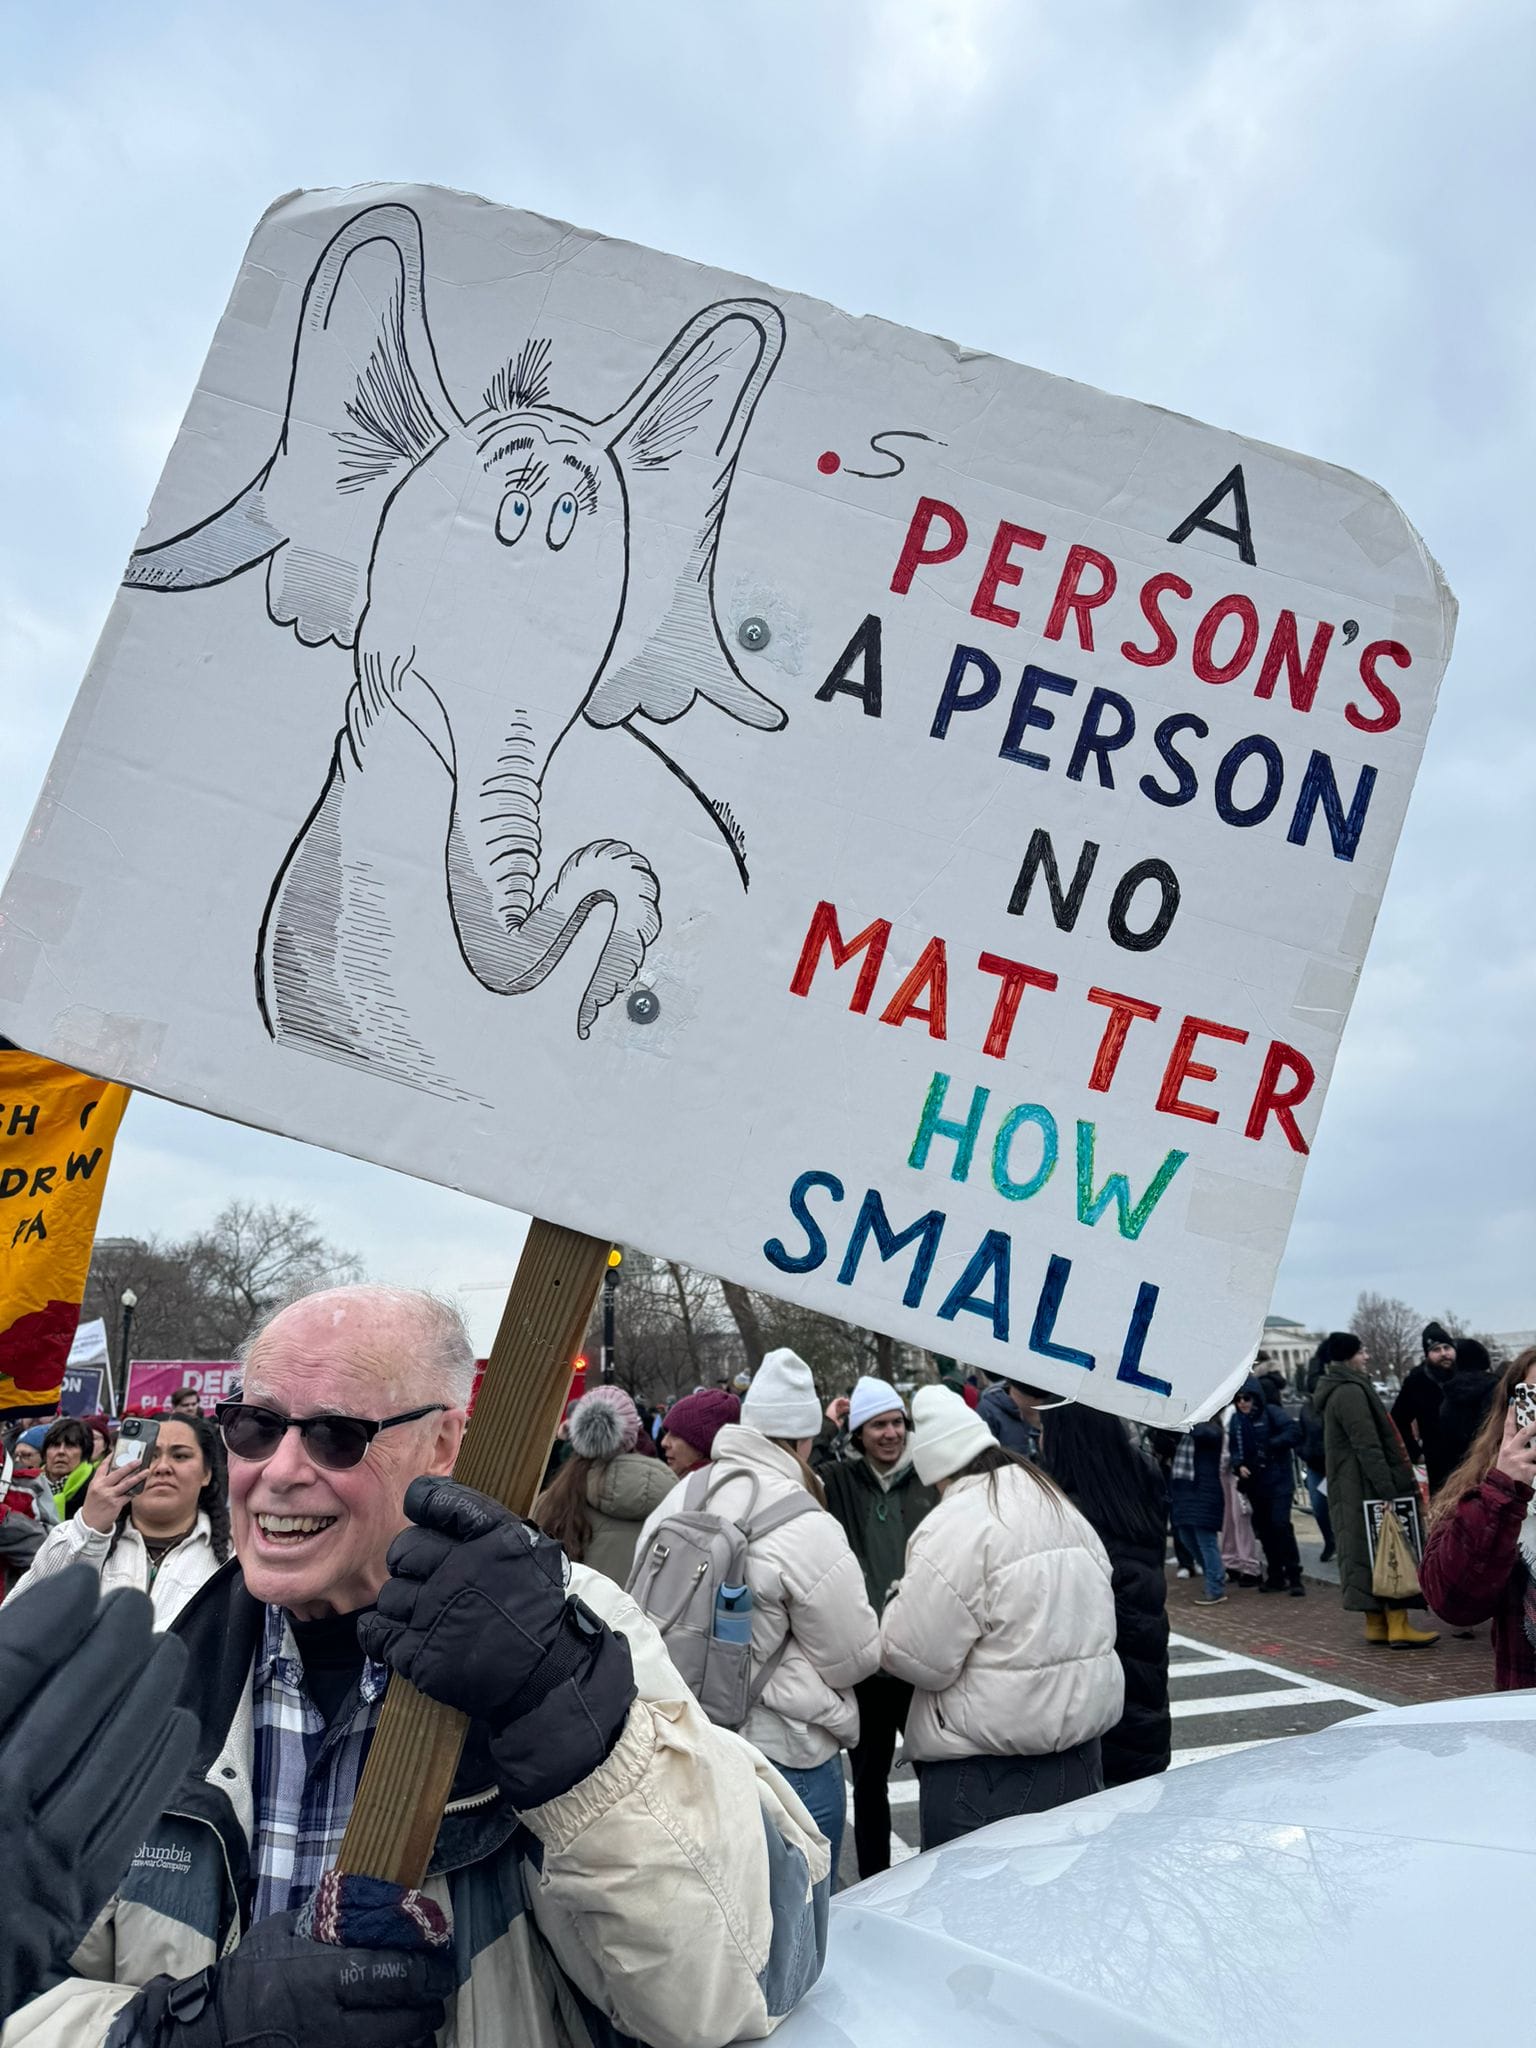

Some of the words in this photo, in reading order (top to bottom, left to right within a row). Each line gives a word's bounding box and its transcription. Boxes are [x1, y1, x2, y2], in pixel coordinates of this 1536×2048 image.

[1167, 464, 1257, 566] A
[890, 496, 1412, 733] PERSON'S
[815, 614, 883, 718] A
[929, 644, 1378, 862] PERSON
[1008, 828, 1182, 952] NO
[789, 900, 1316, 1156] MATTER
[908, 1071, 1190, 1241] HOW
[763, 1170, 1173, 1397] SMALL
[140, 1394, 221, 1412] PLAED
[134, 1842, 192, 1863] olumbia
[340, 1961, 367, 1986] HOT
[372, 1962, 408, 1980] PAWS
